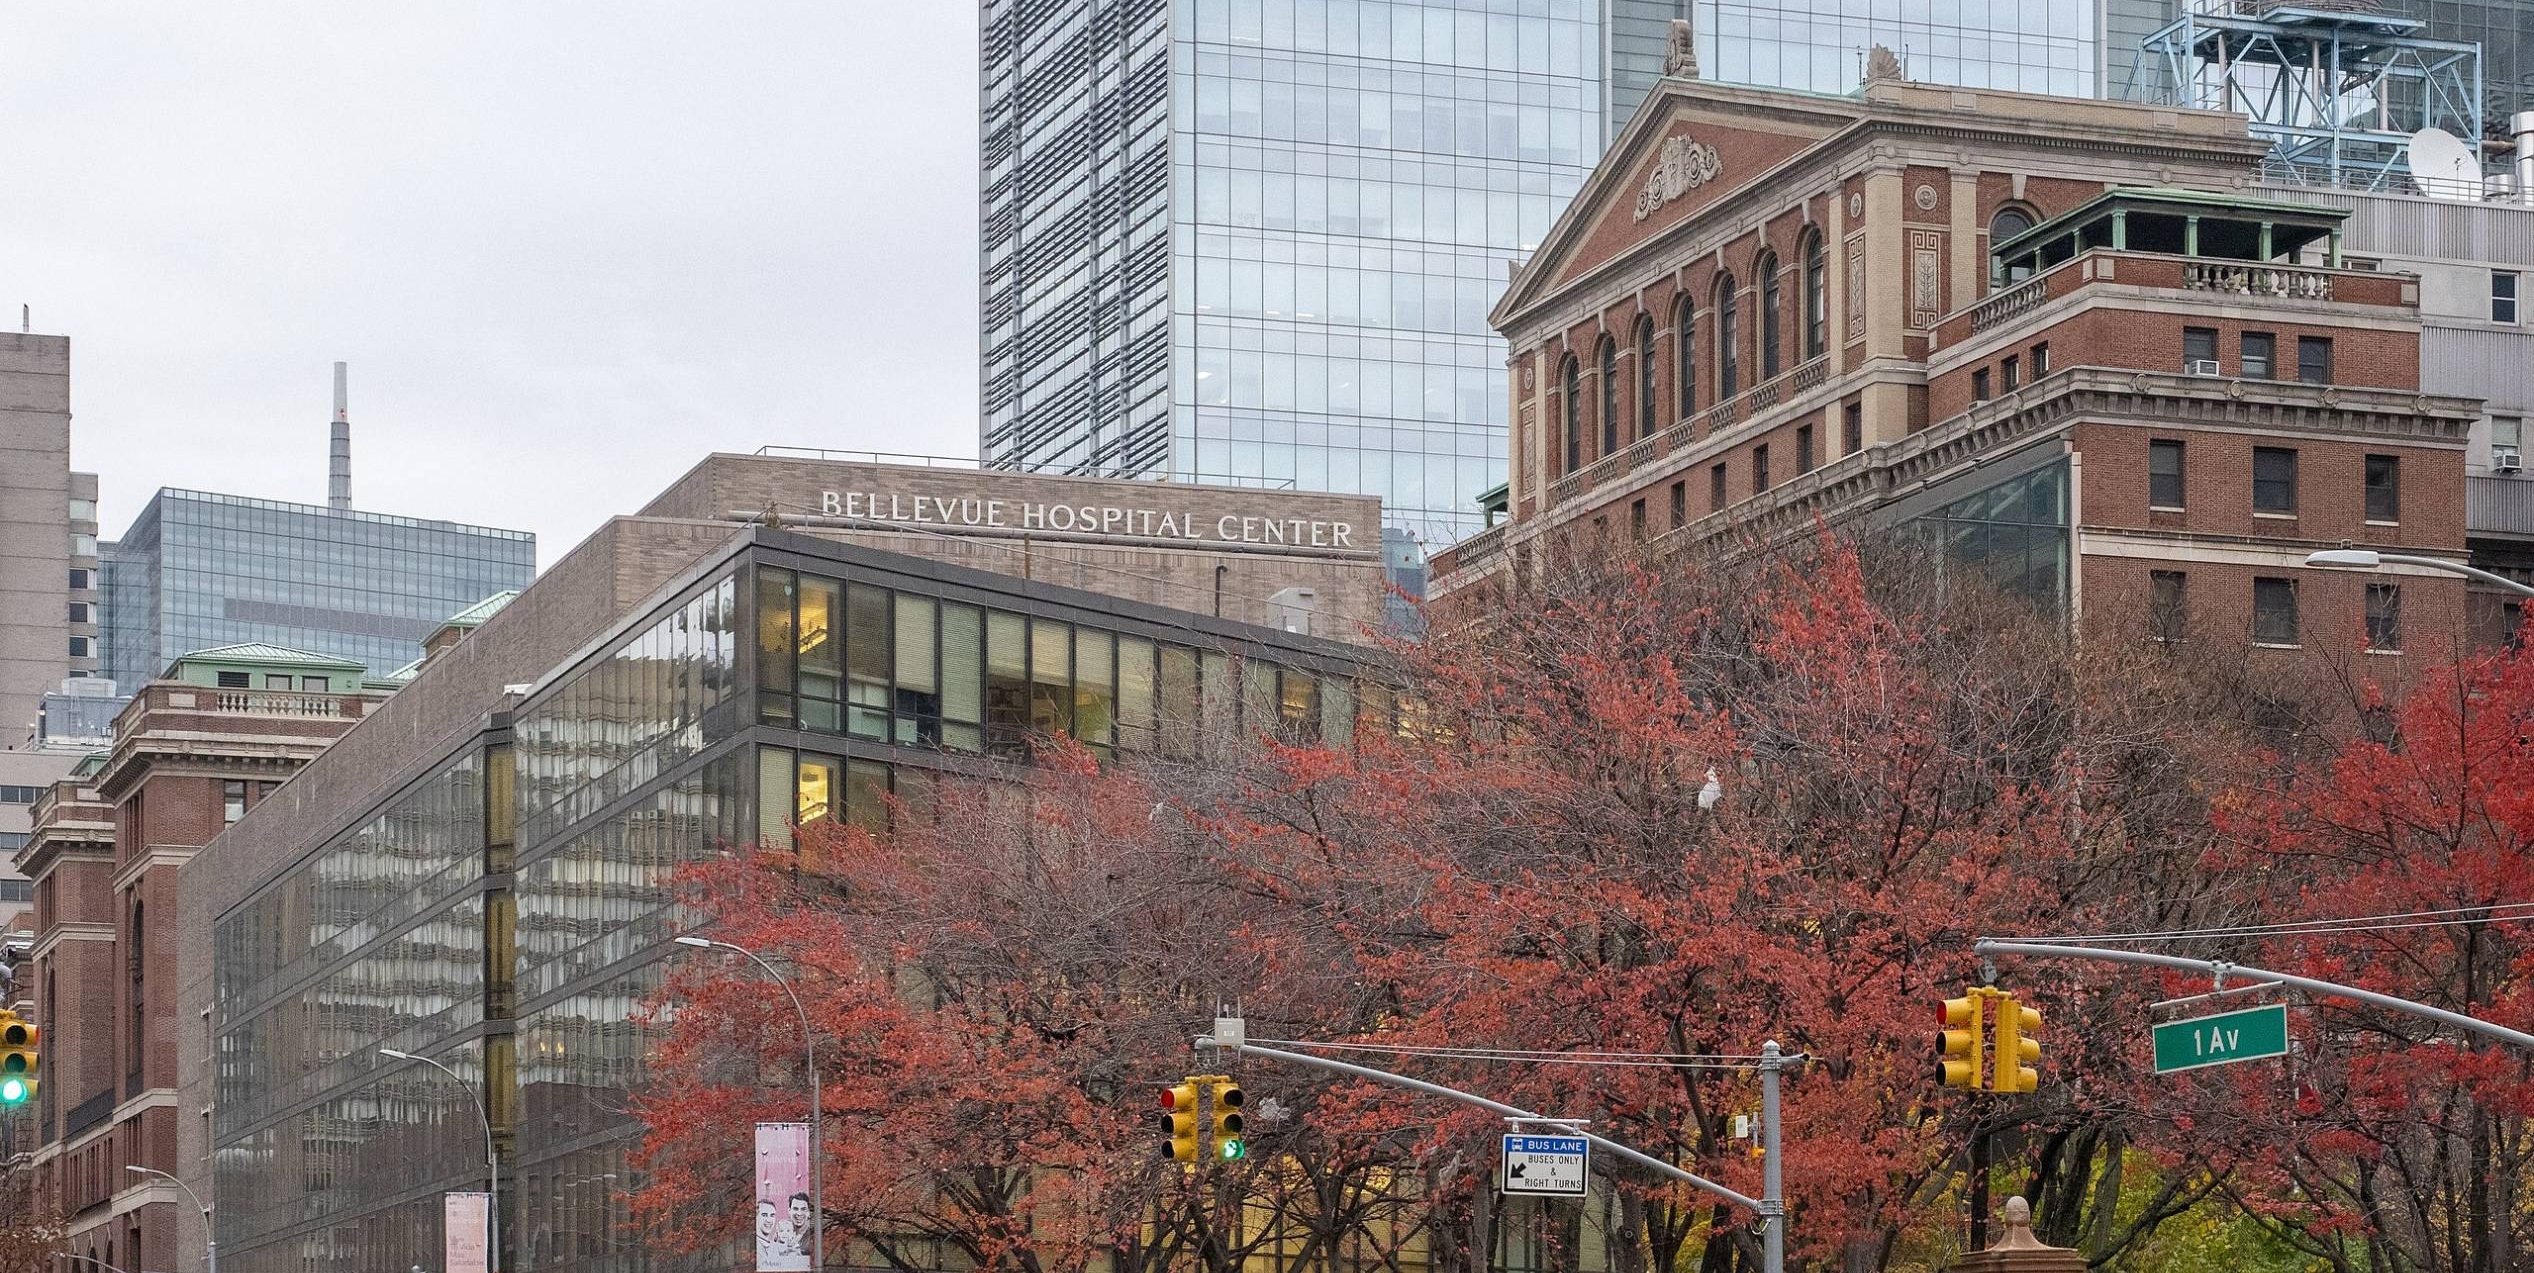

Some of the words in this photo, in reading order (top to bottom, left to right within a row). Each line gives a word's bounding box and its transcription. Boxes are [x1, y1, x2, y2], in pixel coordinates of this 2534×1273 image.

[822, 491, 1005, 527] BELLEVUE
[1023, 502, 1202, 539] HOSPITAL
[1217, 515, 1352, 547] CENTER
[2194, 1029, 2202, 1056] 1
[2209, 1026, 2239, 1054] Av
[1528, 1141, 1550, 1150] BUS
[1553, 1142, 1582, 1151] LANE
[1528, 1155, 1554, 1164] BUSES
[1558, 1156, 1579, 1165] ONLY
[1550, 1167, 1557, 1176] &
[1525, 1178, 1549, 1188] RIGHT
[1554, 1179, 1581, 1189] TURNS
